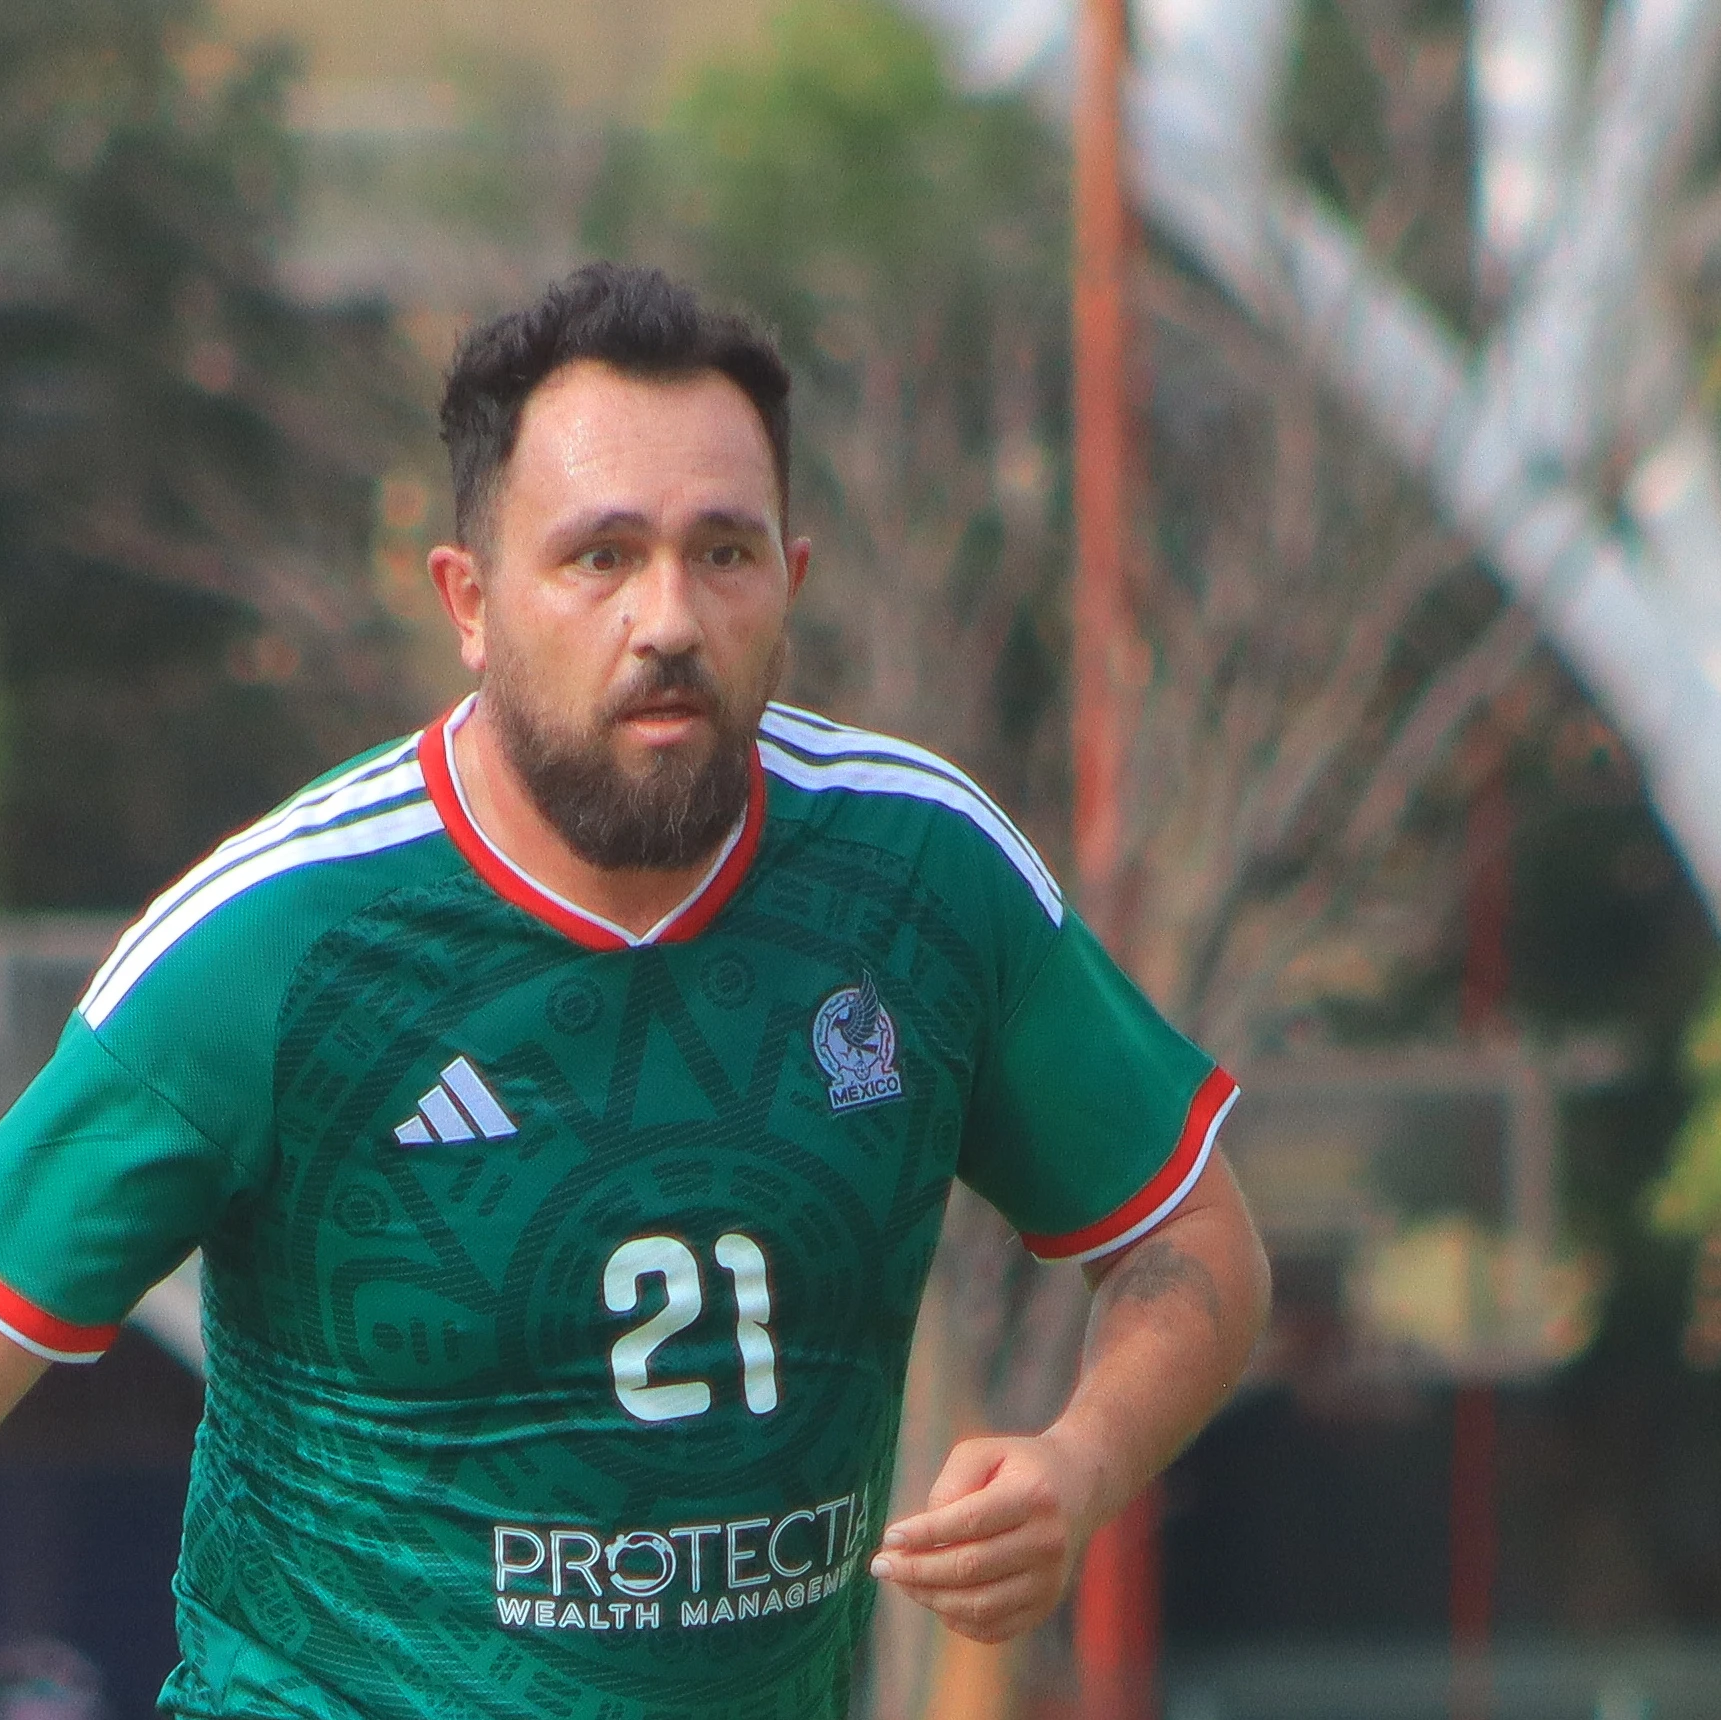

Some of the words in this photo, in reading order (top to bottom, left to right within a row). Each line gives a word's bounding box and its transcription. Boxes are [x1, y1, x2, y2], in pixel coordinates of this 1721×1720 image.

[832, 1075, 900, 1107] MÉXICO
[603, 1232, 778, 1422] 21
[495, 1597, 661, 1630] WEALTH
